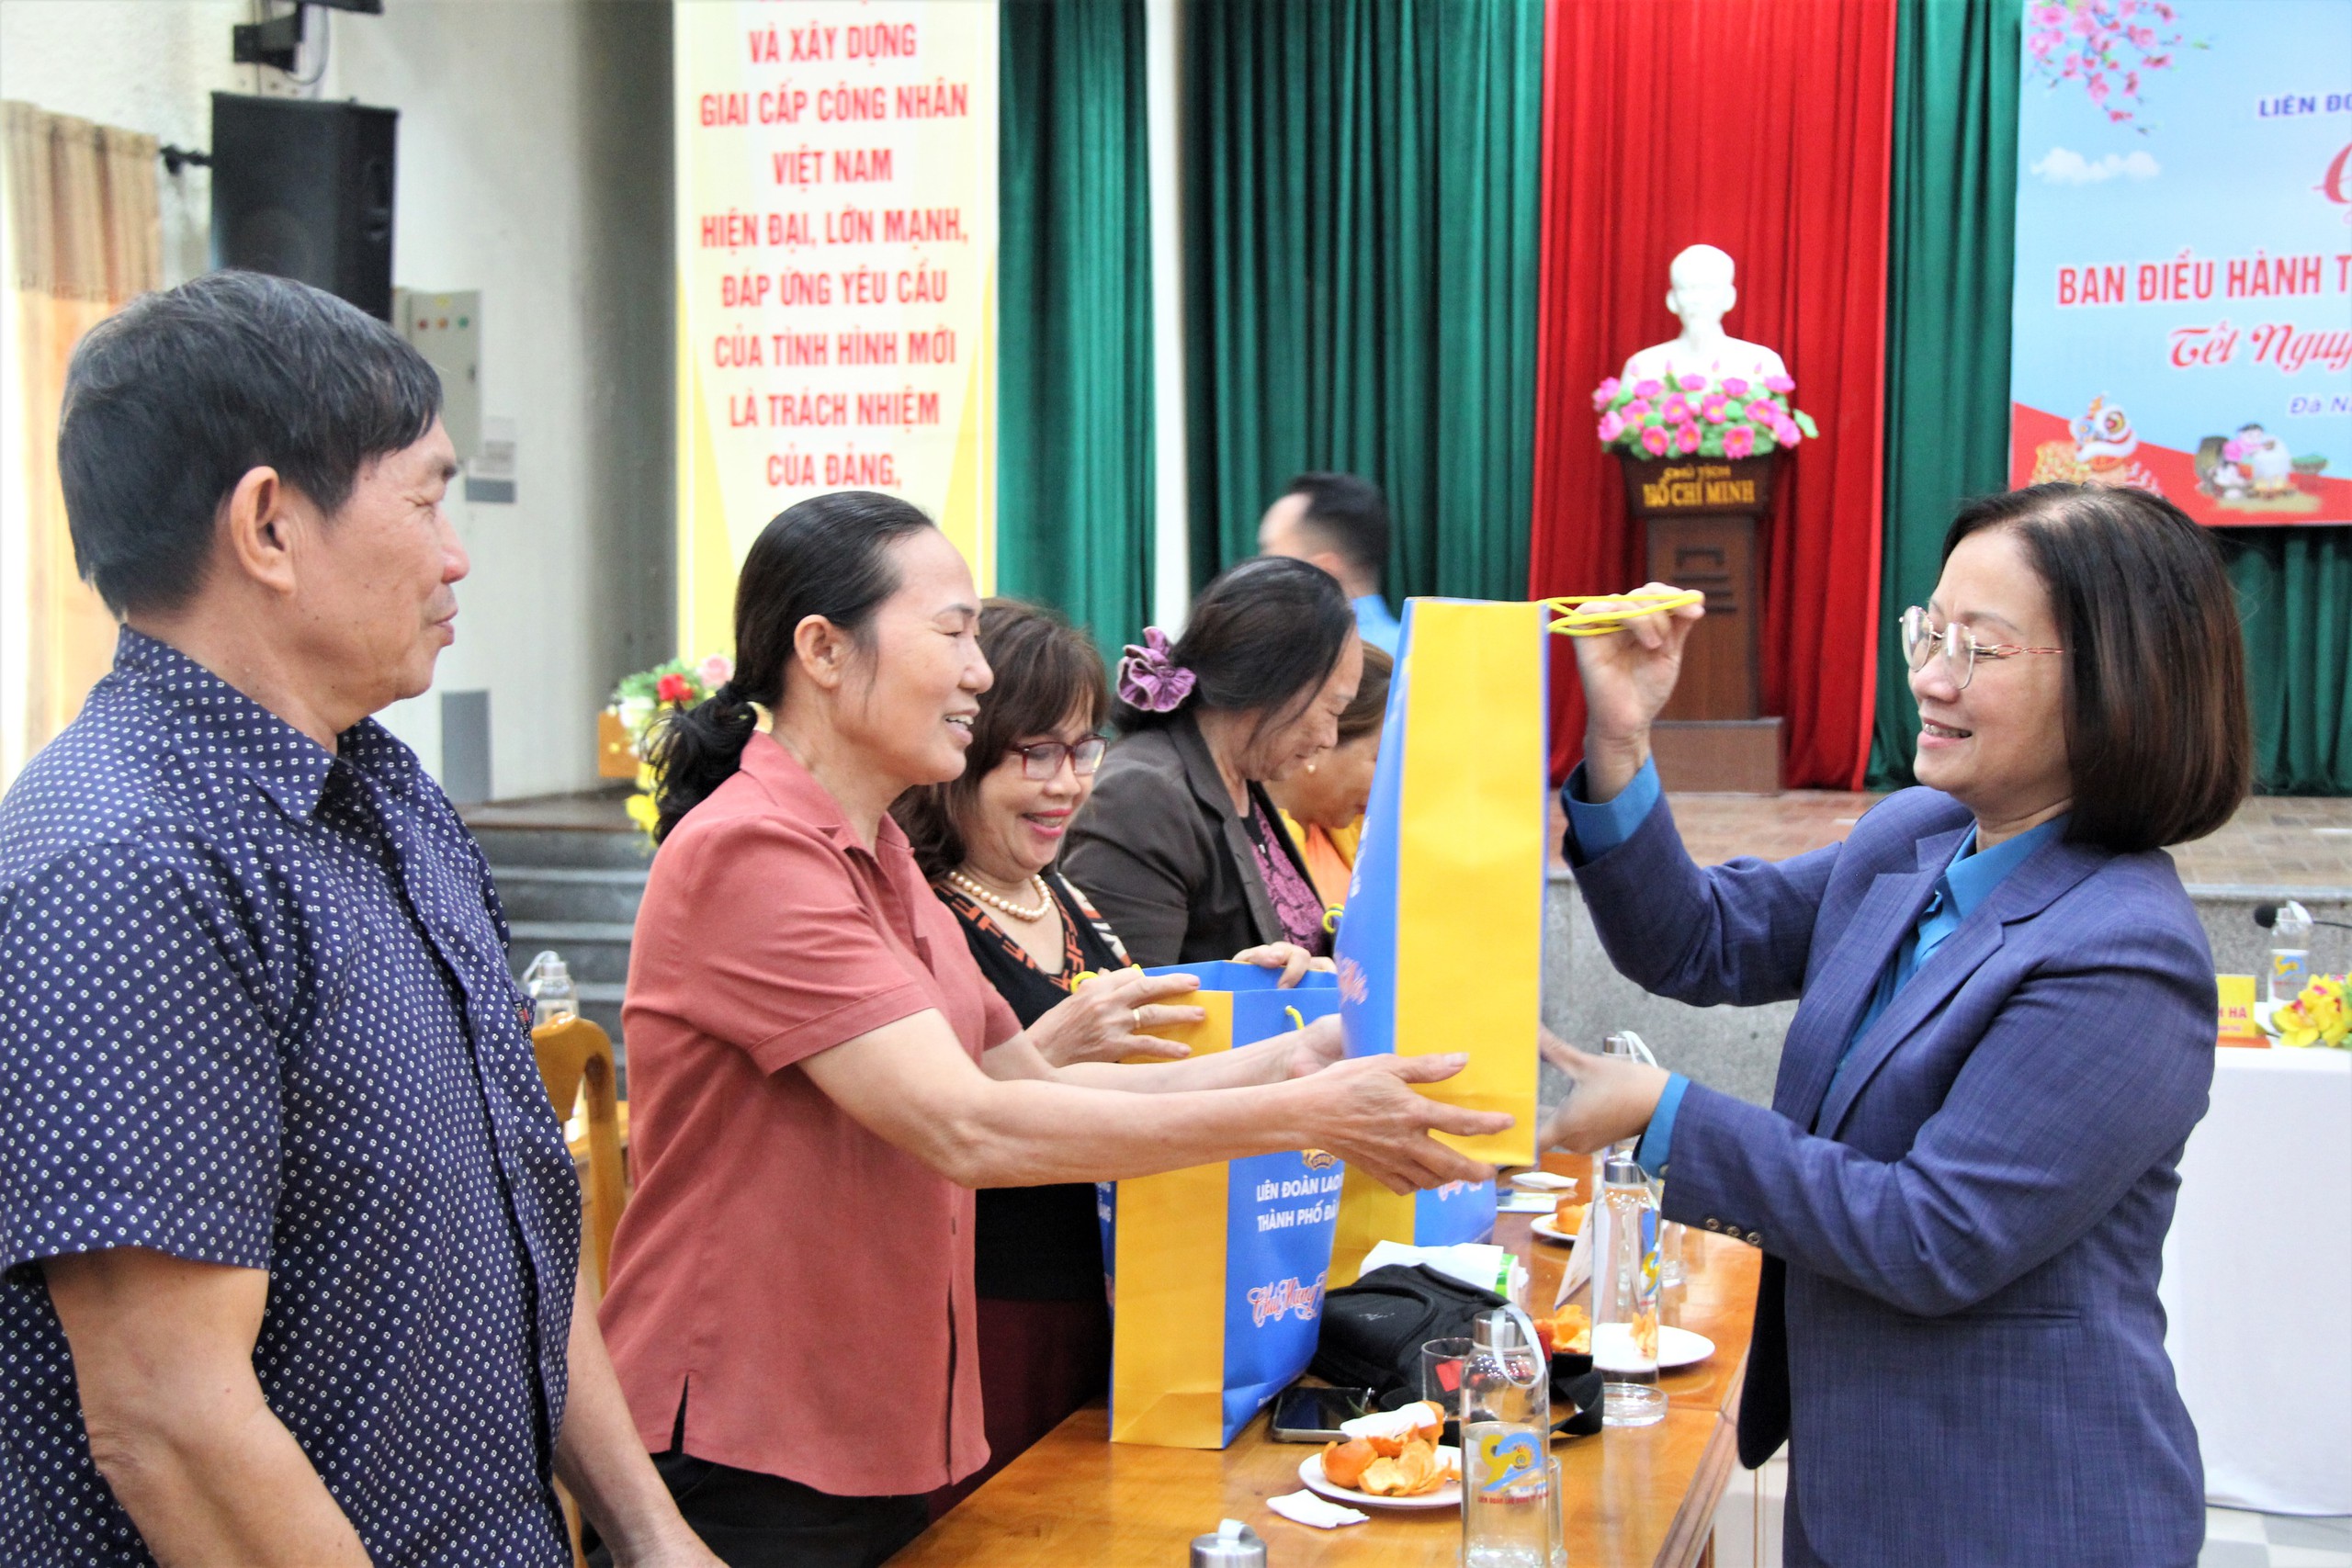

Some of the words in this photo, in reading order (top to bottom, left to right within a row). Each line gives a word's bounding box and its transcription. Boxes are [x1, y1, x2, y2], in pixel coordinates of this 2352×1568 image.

[750, 22, 782, 65] VÀ
[790, 21, 839, 63] XÂY
[847, 22, 918, 67] DỰNG
[700, 93, 751, 129] GIAI
[759, 78, 809, 126] CẤP
[818, 82, 888, 124] CÔNG
[897, 76, 968, 120] NHÂN
[2258, 95, 2315, 116] LIÊN
[773, 145, 826, 193] VIỆT
[834, 149, 894, 184] NAM
[702, 209, 760, 255] HIỆN
[767, 213, 818, 254] ĐẠI,
[826, 203, 876, 246] LỚN
[884, 209, 969, 251] MẠNH,
[722, 267, 773, 309] ĐÁP
[781, 268, 832, 308] ỨNG
[842, 265, 888, 306] YÊU
[2056, 265, 2127, 306] BAN
[2226, 250, 2322, 298] HÀNH
[715, 325, 764, 369] CỦA
[773, 327, 830, 367] TÌNH
[838, 325, 899, 367] HÌNH
[908, 325, 956, 366] MỚI
[2170, 321, 2238, 367] Tết
[730, 388, 760, 428] LÀ
[767, 387, 848, 427] TRÁCH
[857, 387, 940, 434] NHIỆM
[767, 445, 817, 489] CỦA
[825, 444, 902, 489] ĐẢNG,
[1706, 479, 1755, 504] MINH
[1256, 1179, 1279, 1201] LIÊN
[1282, 1175, 1319, 1198] ĐOÀN
[1257, 1208, 1295, 1232] THÀNH
[1297, 1199, 1324, 1225] PHỐ
